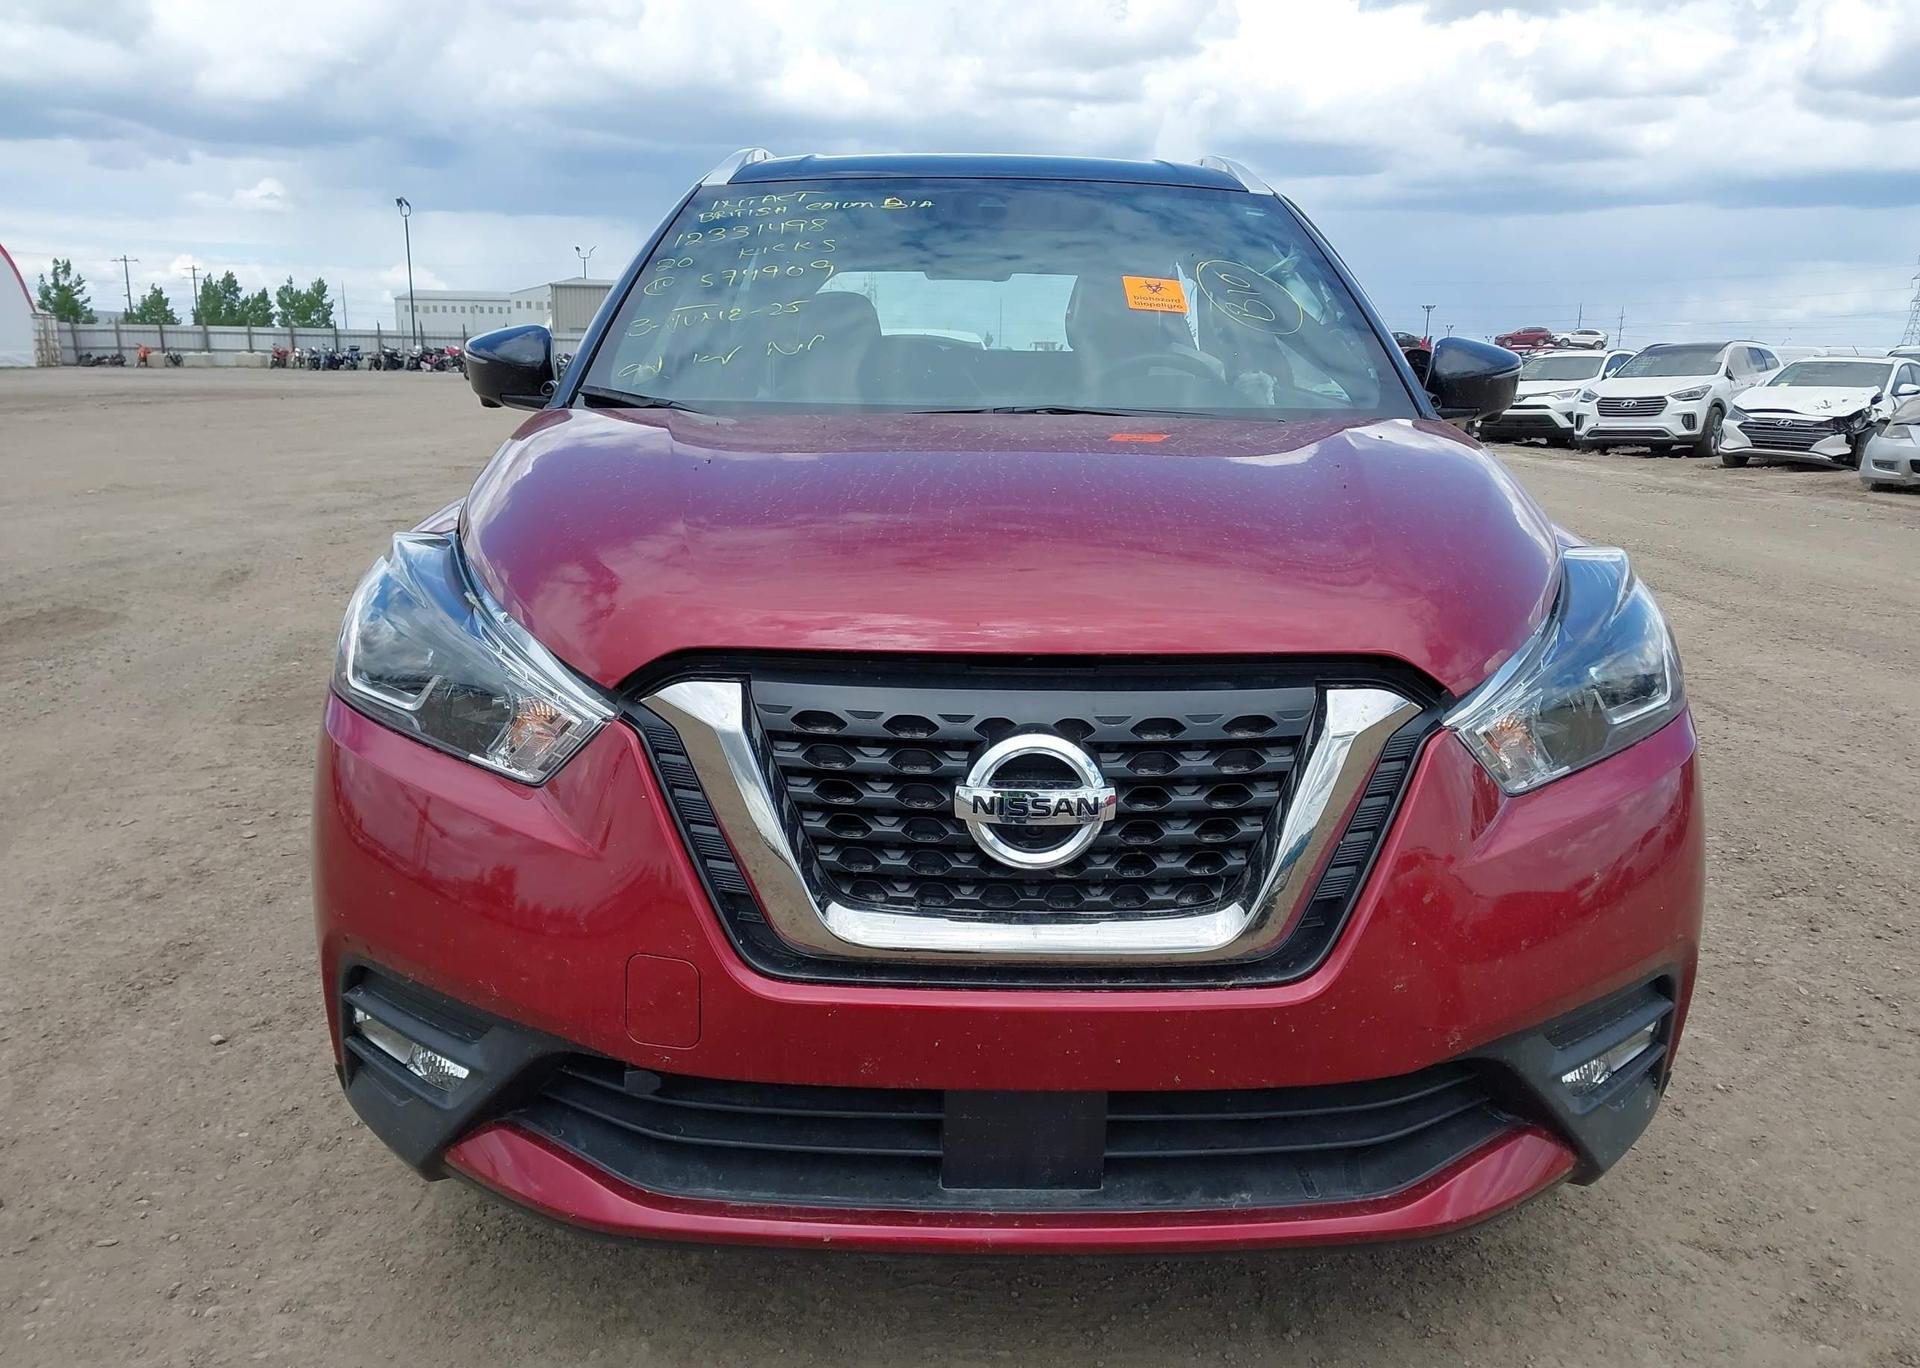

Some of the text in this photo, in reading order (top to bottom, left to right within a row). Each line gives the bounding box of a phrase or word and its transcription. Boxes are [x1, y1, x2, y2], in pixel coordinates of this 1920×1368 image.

[698, 206, 787, 223] BRITISH
[674, 218, 828, 249] 12331498
[655, 239, 836, 272] 20 KICKS
[1133, 295, 1181, 304] biohazard
[1133, 301, 1184, 310] biopeligro
[972, 795, 1100, 818] NISSAN
